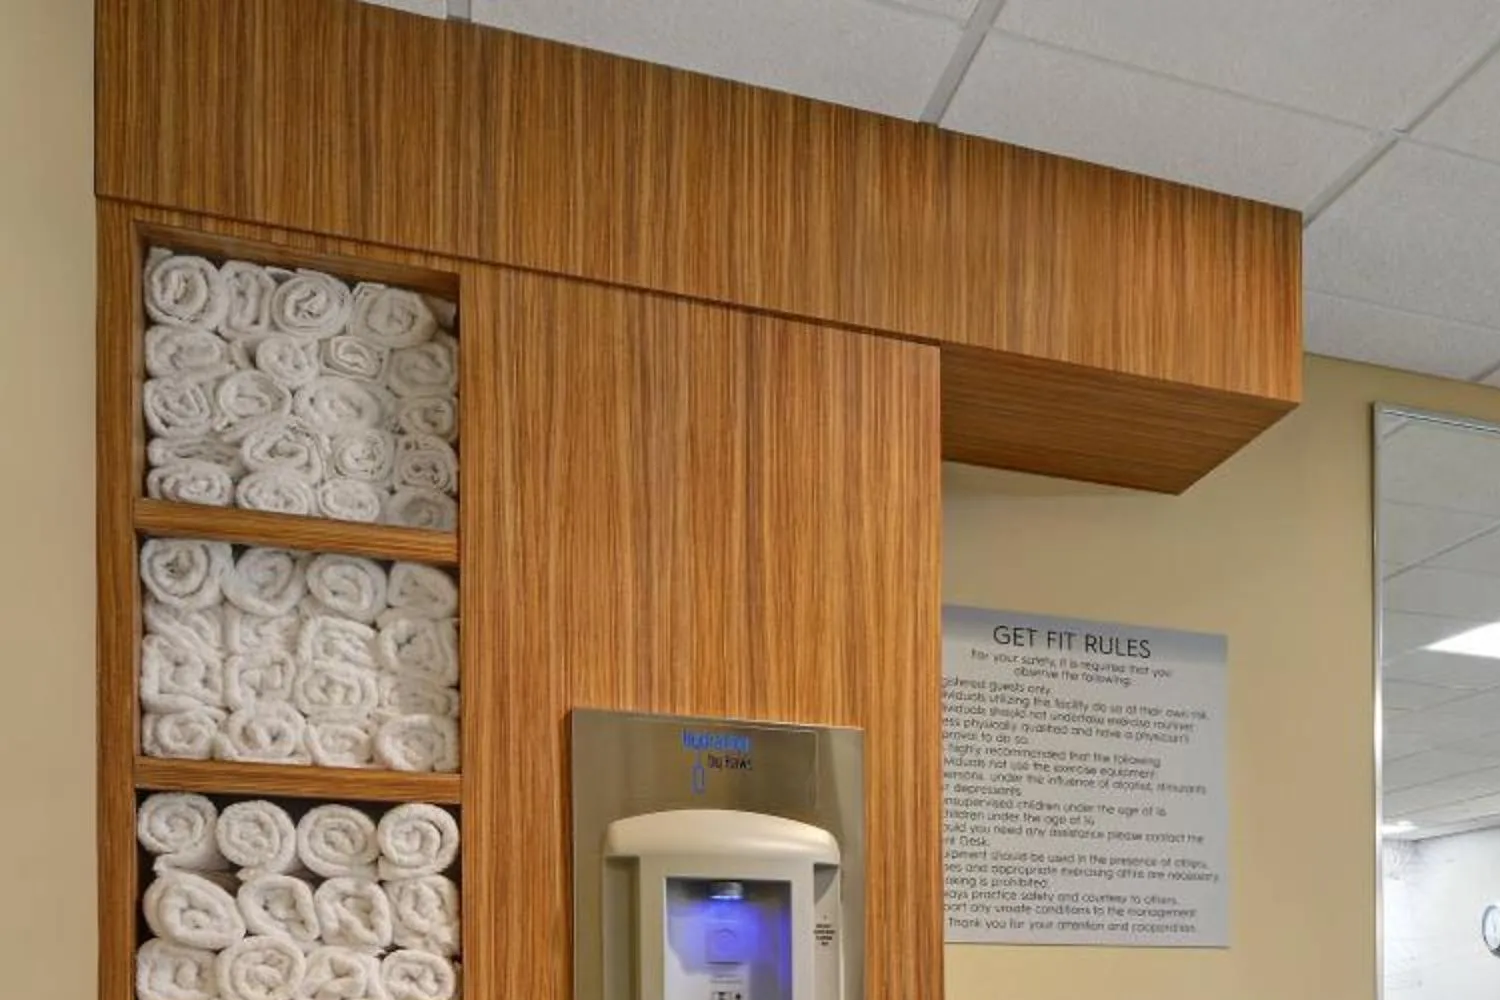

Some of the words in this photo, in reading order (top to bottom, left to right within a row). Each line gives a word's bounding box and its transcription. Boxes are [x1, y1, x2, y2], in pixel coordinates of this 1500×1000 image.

[993, 625, 1038, 648] GET
[1047, 629, 1077, 652] FIT
[1085, 633, 1151, 659] RULES
[993, 653, 1018, 665] your
[985, 745, 1066, 760] recommended
[988, 811, 1019, 822] under
[994, 824, 1022, 835] need
[949, 917, 980, 928] Thank
[1029, 922, 1053, 932] your
